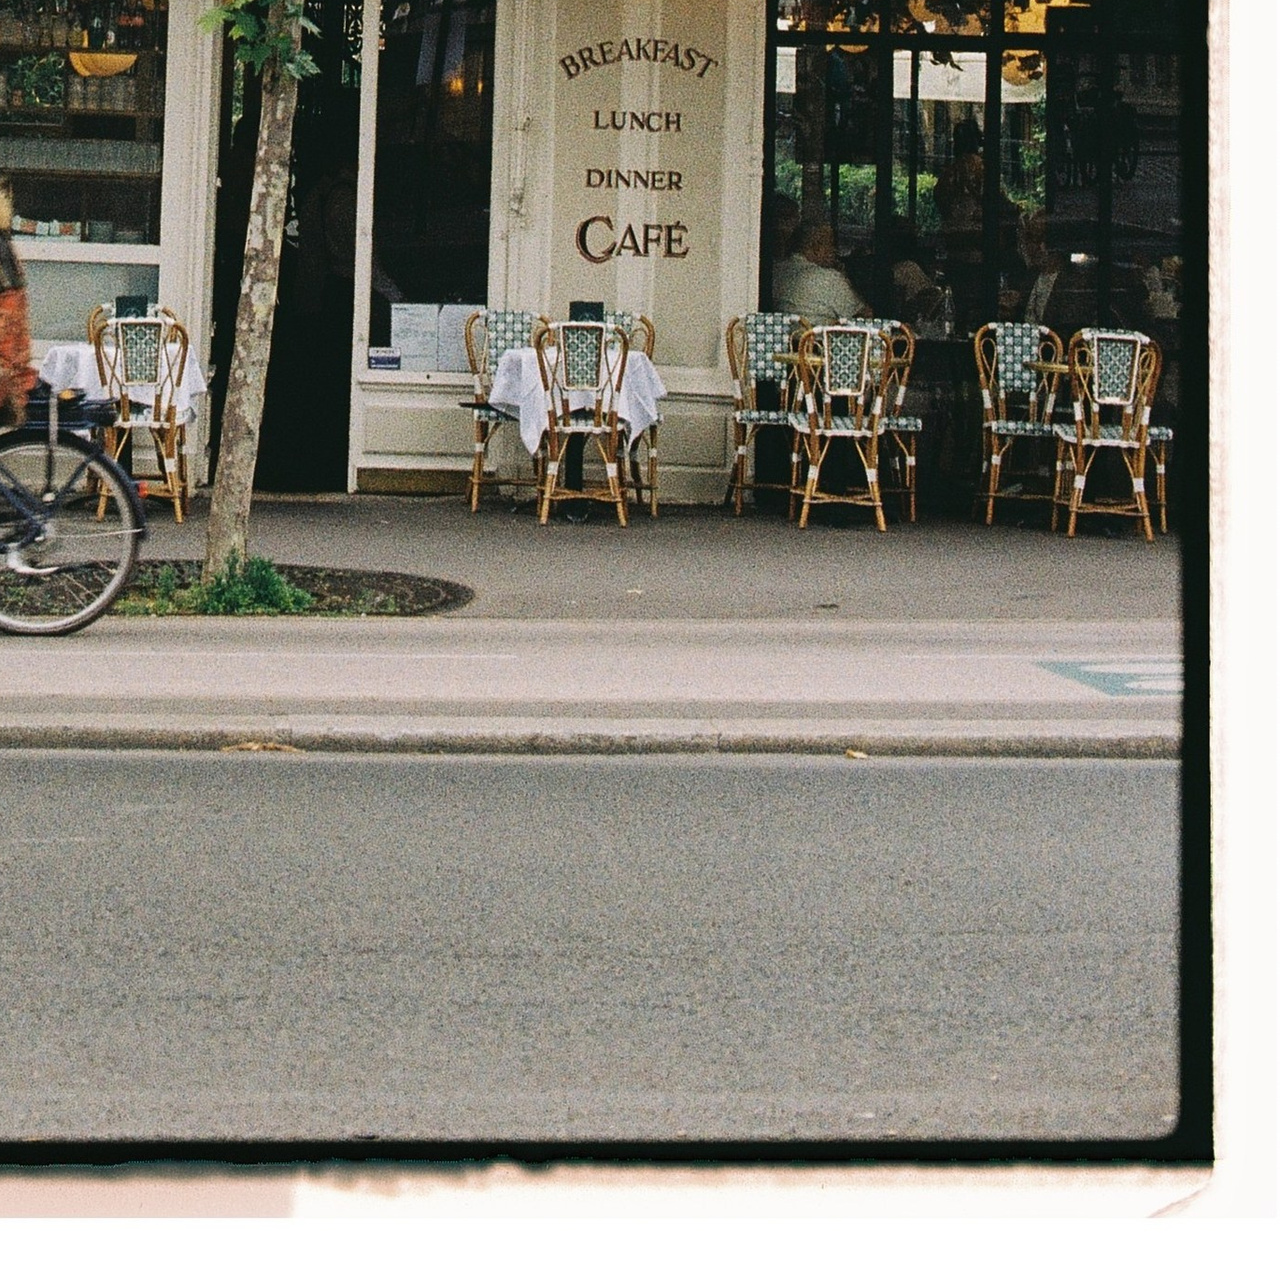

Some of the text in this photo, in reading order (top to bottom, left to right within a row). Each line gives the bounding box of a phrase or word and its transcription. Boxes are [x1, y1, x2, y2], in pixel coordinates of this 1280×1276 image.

[559, 38, 719, 80] BREAKFAST
[593, 110, 682, 133] LUNCH
[585, 168, 683, 191] DINNER
[575, 215, 690, 264] CAFÉ
